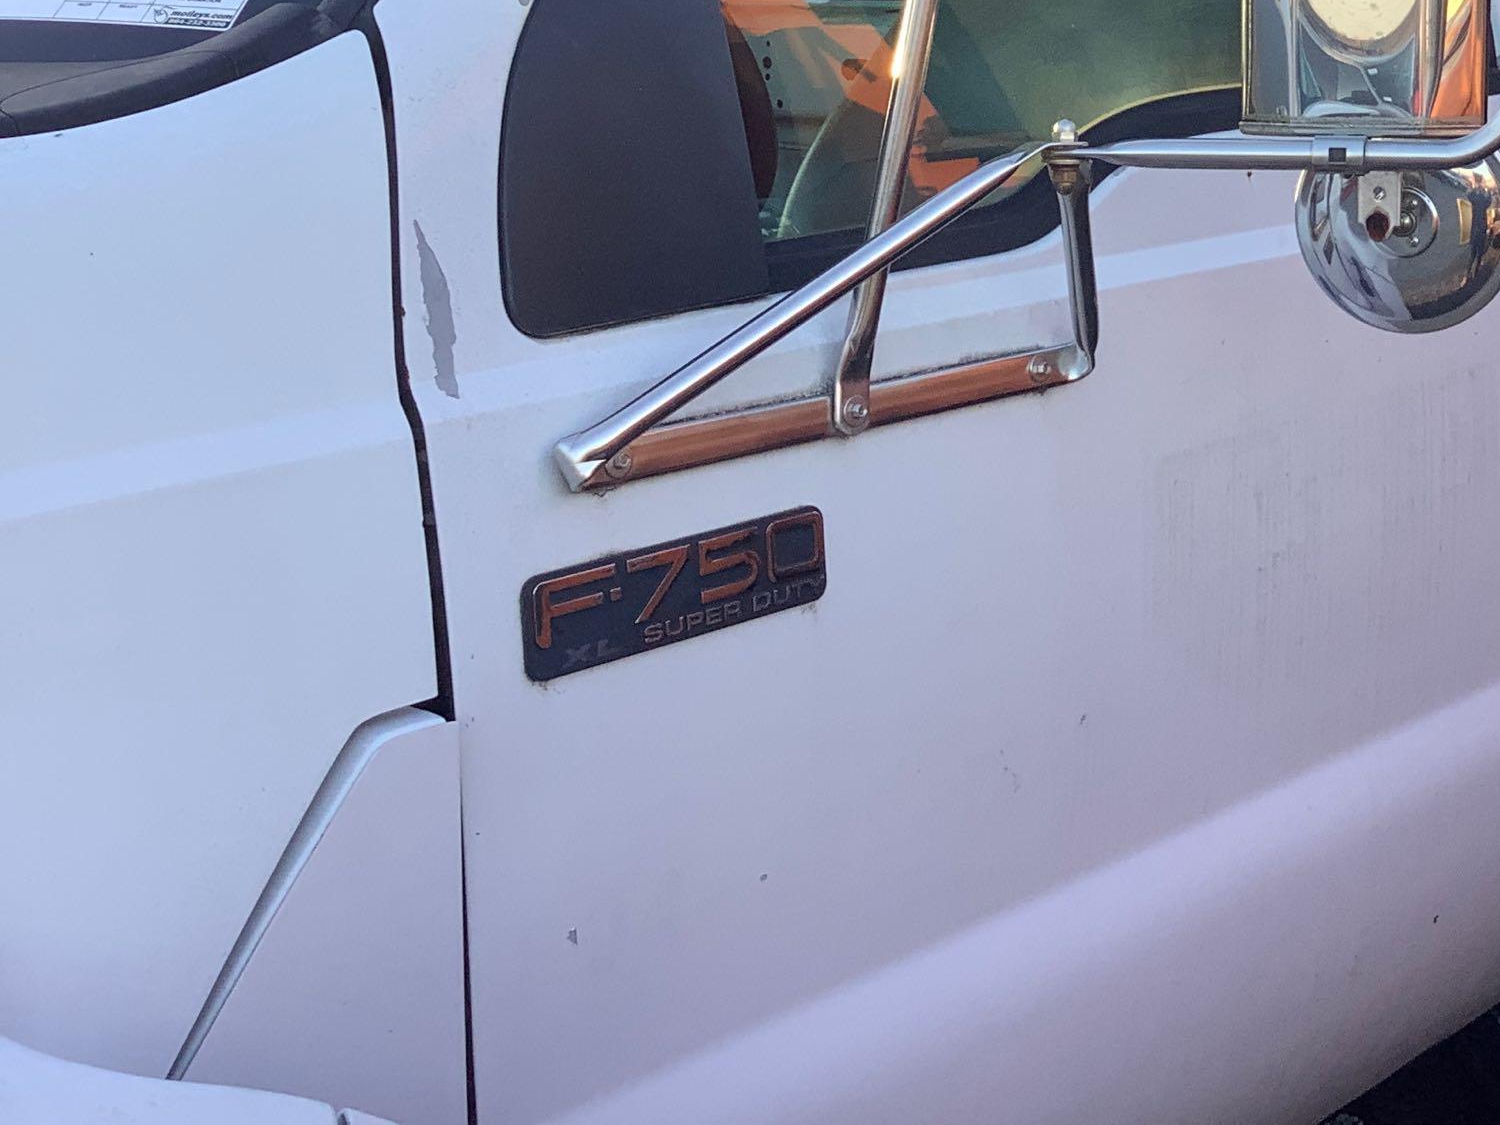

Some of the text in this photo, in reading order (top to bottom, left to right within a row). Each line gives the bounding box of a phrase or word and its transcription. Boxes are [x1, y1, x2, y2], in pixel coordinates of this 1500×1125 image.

[532, 510, 825, 650] F-750
[643, 576, 825, 645] SUPER DUTY
